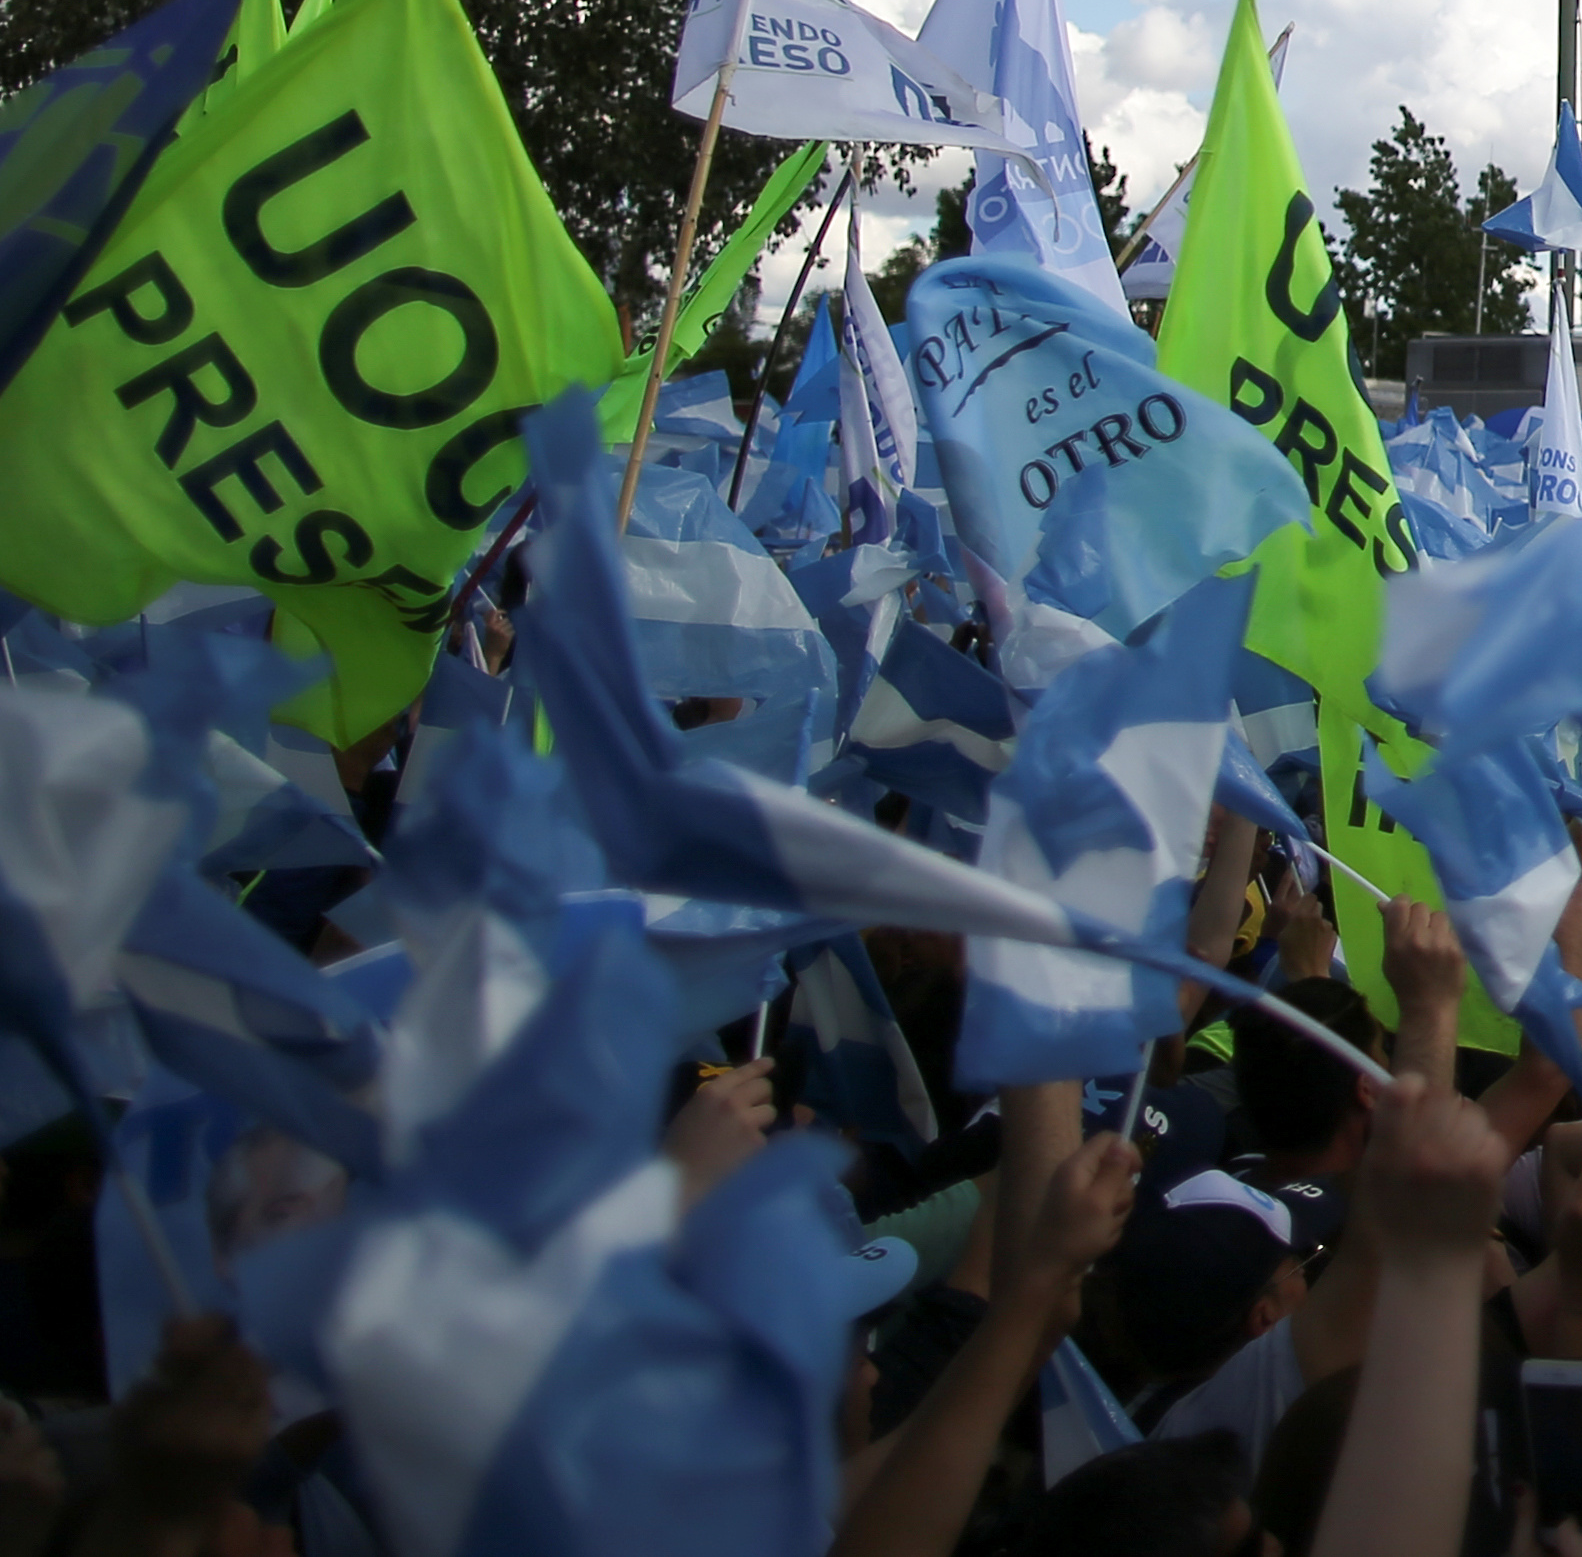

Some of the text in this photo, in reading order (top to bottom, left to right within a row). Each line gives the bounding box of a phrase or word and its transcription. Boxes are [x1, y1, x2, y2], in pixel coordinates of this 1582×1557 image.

[739, 35, 851, 75] ESO
[751, 13, 842, 47] ENDO
[1025, 349, 1101, 425] es el
[1019, 392, 1187, 511] OTRO
